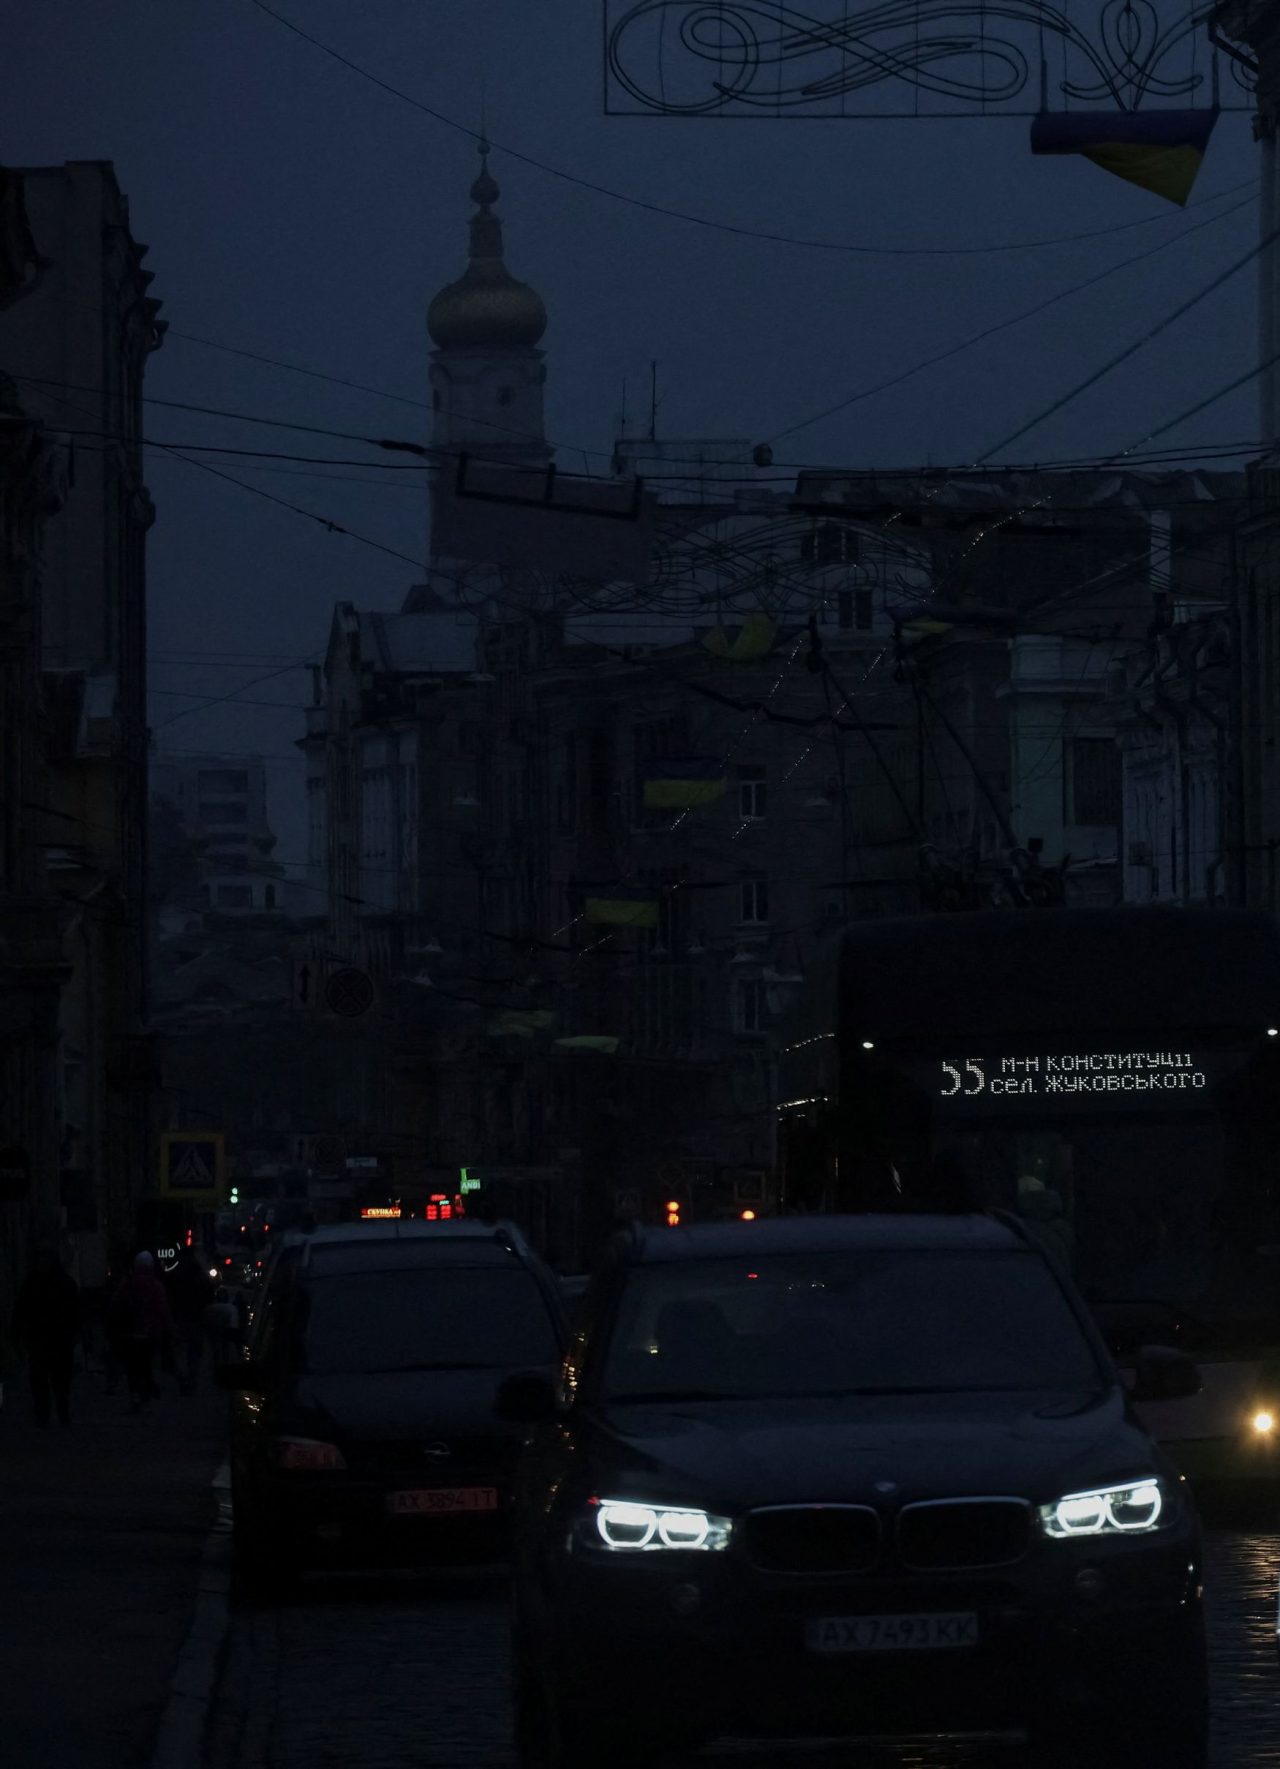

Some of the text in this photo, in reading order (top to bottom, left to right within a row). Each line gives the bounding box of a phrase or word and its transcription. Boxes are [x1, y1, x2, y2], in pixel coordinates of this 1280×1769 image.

[940, 1058, 985, 1095] 55
[1045, 1072, 1206, 1093] ЖУКОВСЬКОГО
[822, 1616, 976, 1647] AX 7493 KK
